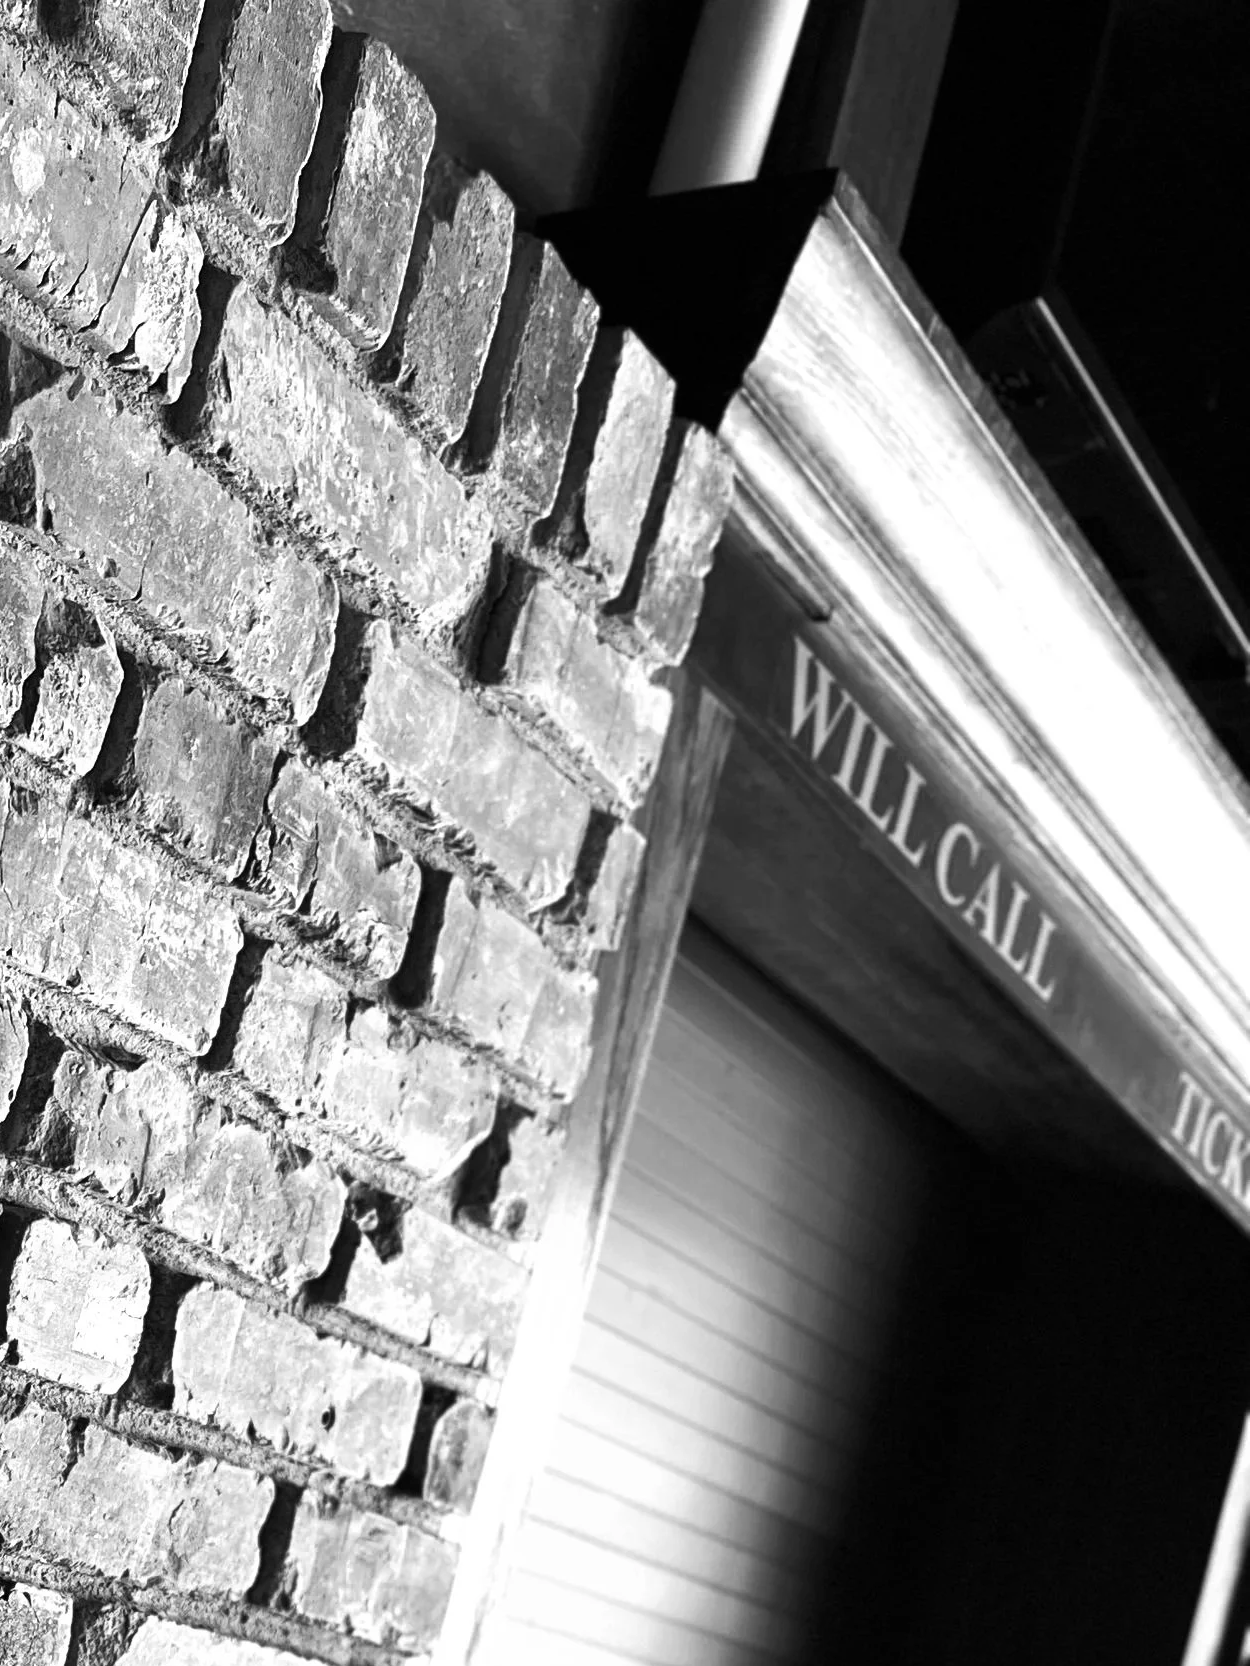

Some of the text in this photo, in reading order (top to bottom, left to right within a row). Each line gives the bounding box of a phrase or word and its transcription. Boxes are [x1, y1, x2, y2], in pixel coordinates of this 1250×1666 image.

[790, 637, 1055, 1000] WILL CALL
[1171, 1071, 1250, 1210] TICK
